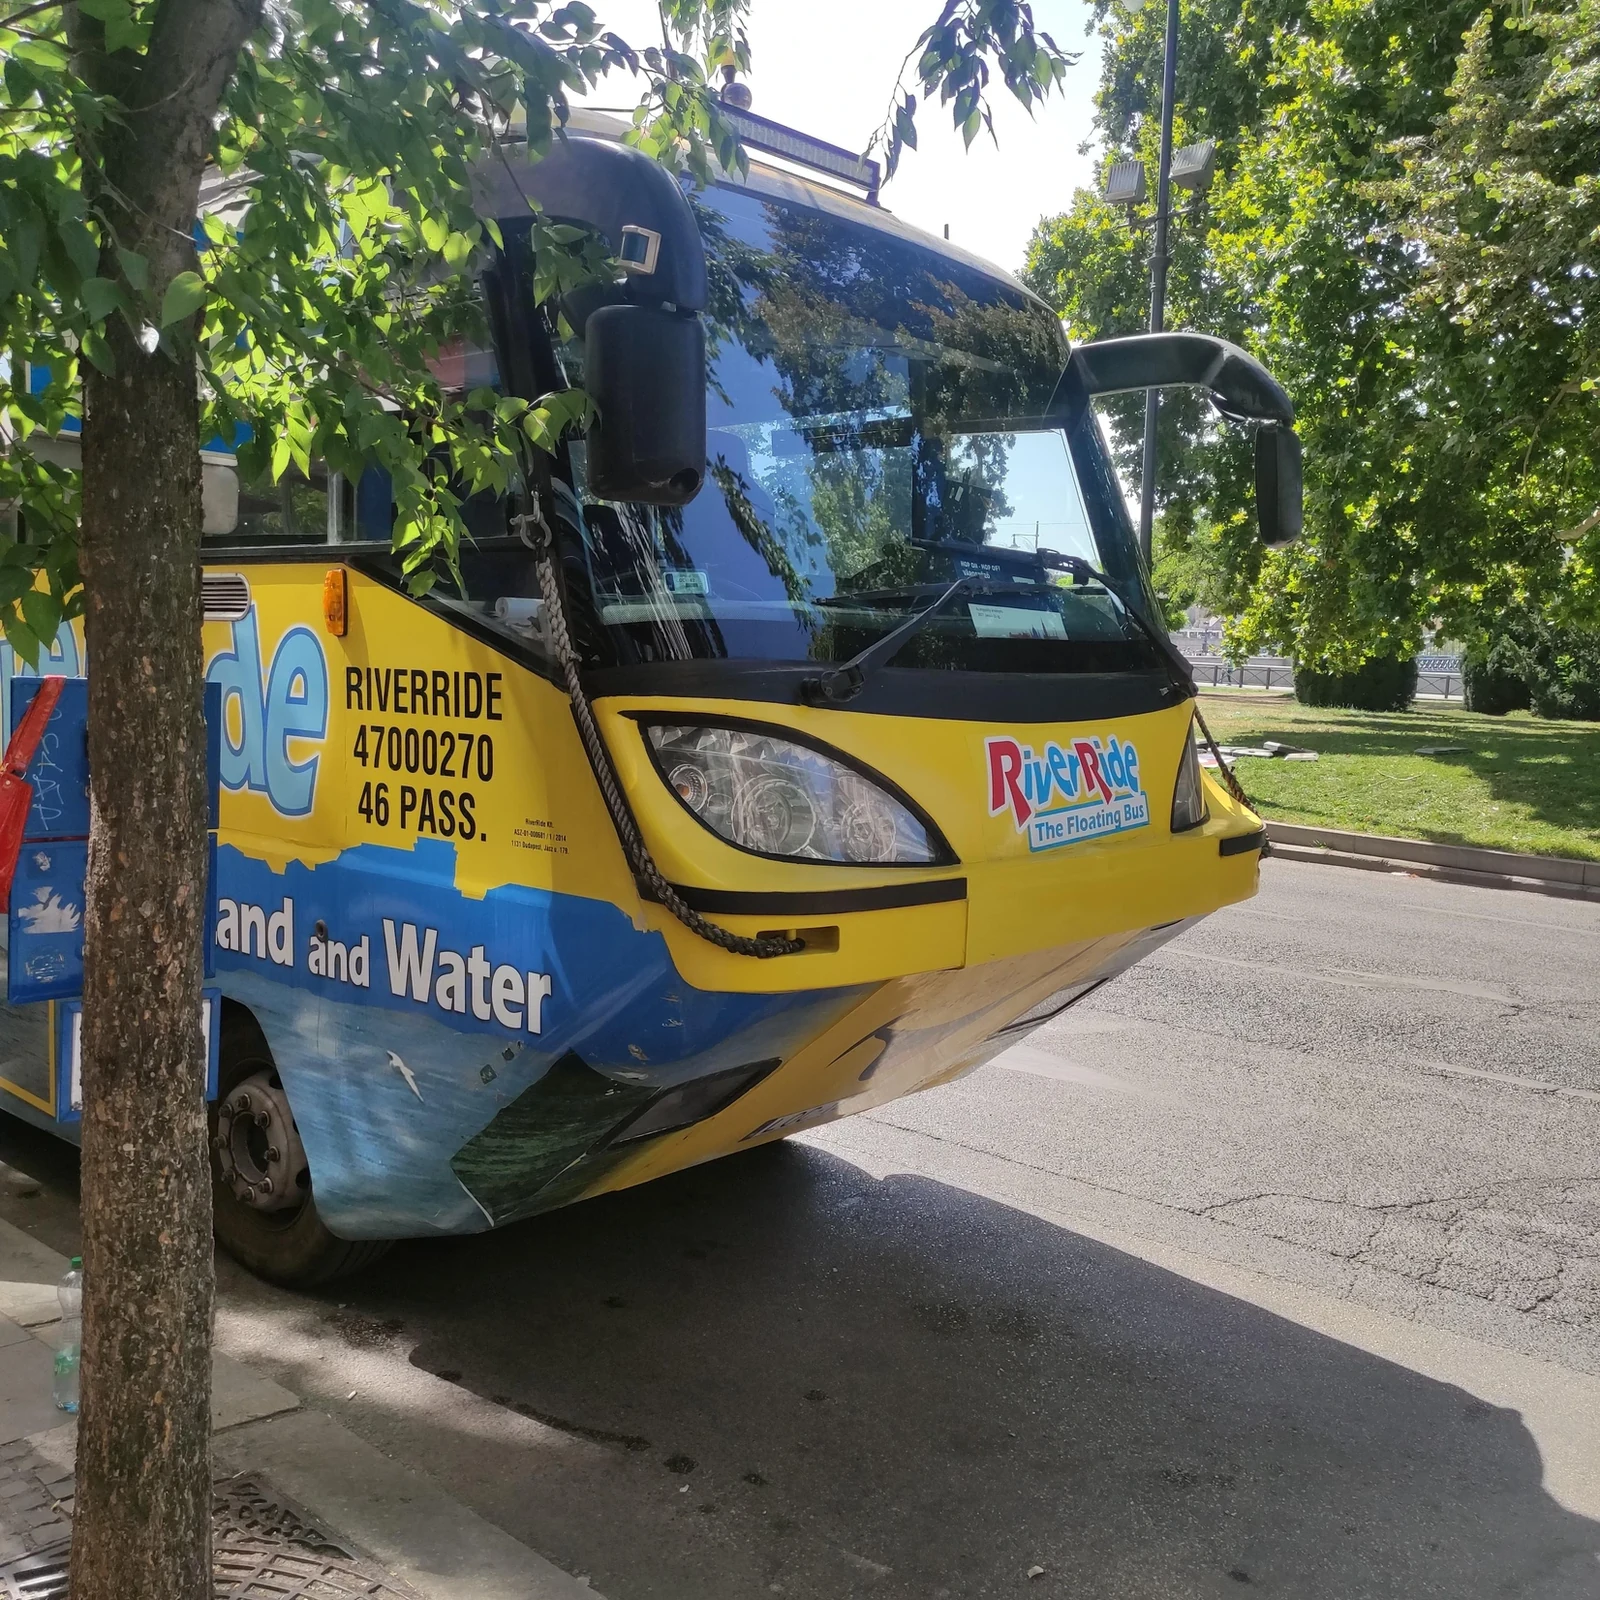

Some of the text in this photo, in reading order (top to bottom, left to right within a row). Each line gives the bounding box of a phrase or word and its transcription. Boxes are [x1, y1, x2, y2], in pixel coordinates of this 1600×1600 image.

[346, 666, 502, 721] RIVERRIDE
[354, 725, 493, 782] 47000270
[358, 781, 487, 842] 46 PASS.
[986, 736, 1140, 831] RiverRide
[555, 834, 567, 842] 2014
[1035, 804, 1145, 842] The Floating Bus
[215, 896, 552, 1035] and and Water
